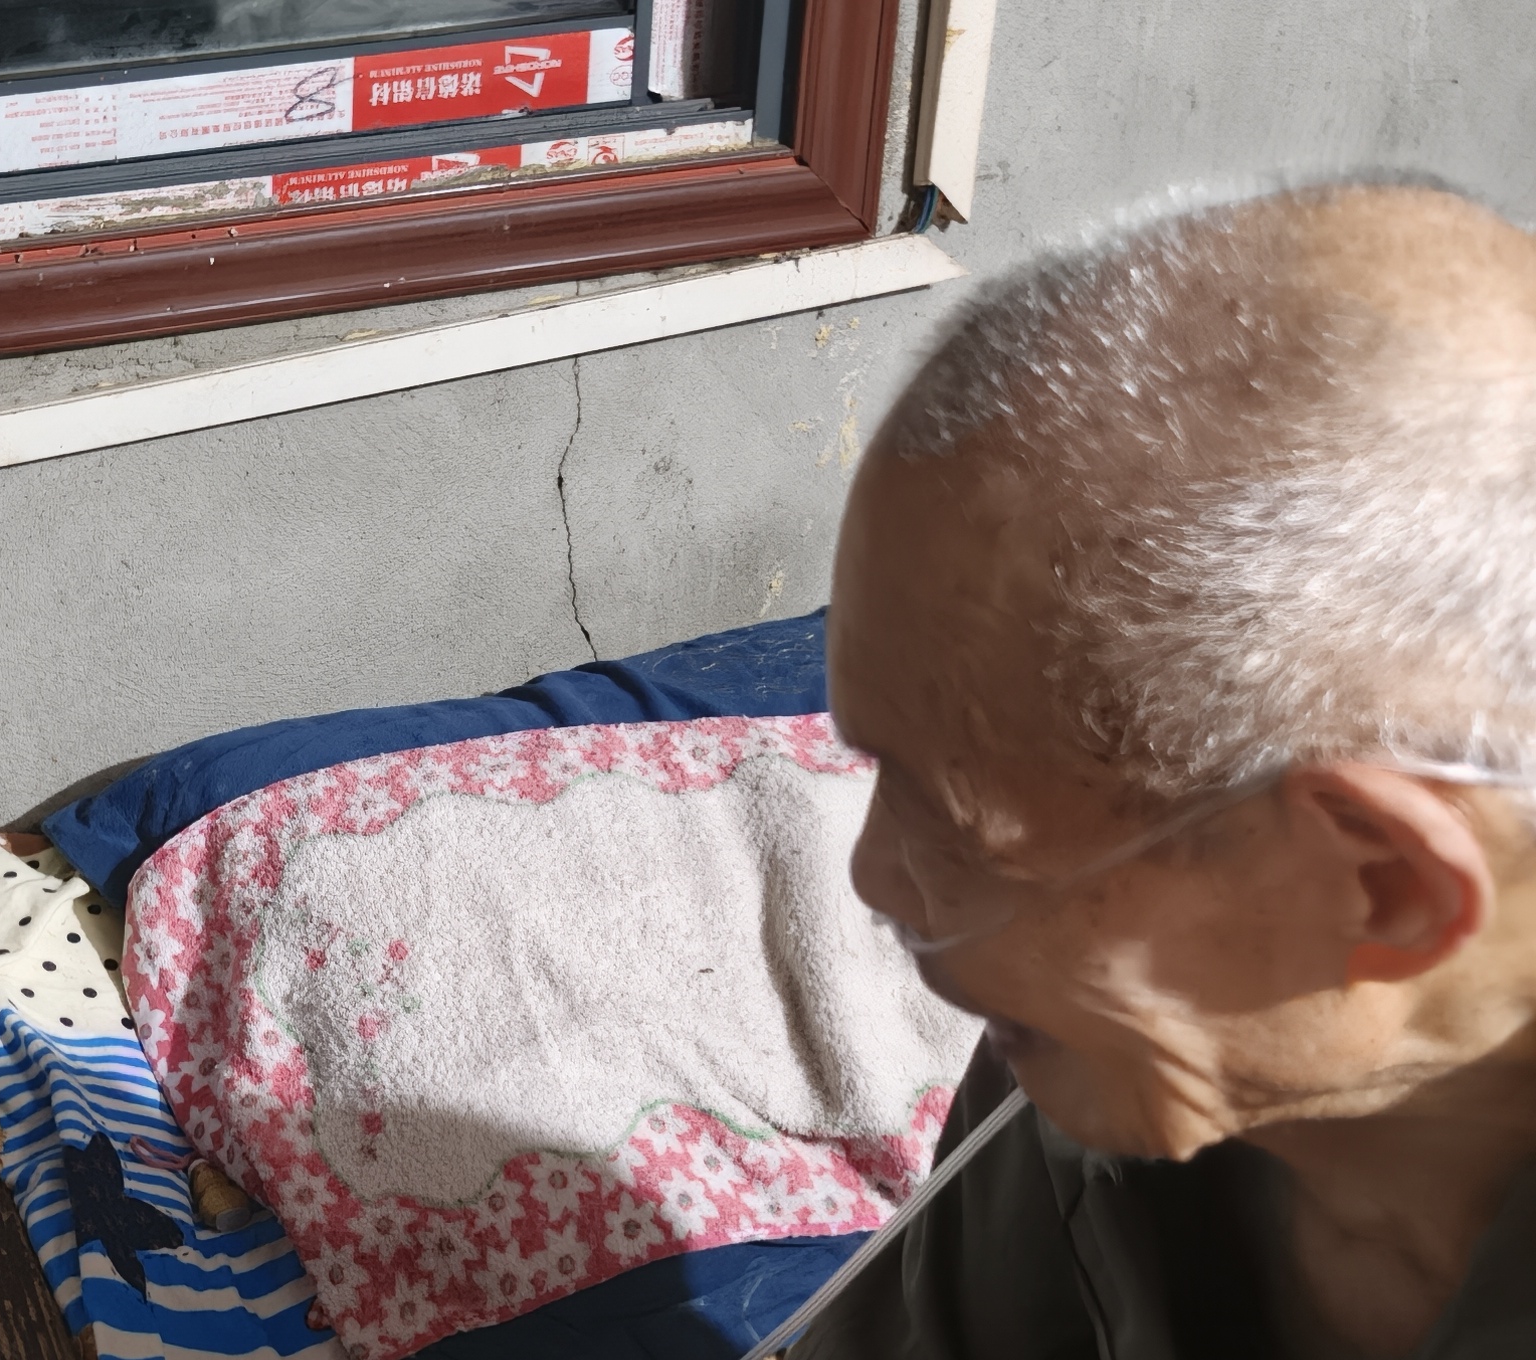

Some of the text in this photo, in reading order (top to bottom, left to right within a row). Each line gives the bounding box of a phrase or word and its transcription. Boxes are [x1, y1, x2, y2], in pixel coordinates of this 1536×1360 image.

[425, 58, 483, 73] NORDSHINE
[369, 71, 483, 107] 诺德信铝材
[288, 170, 346, 186] ALUMINUM
[347, 163, 409, 179] NORDSHINE
